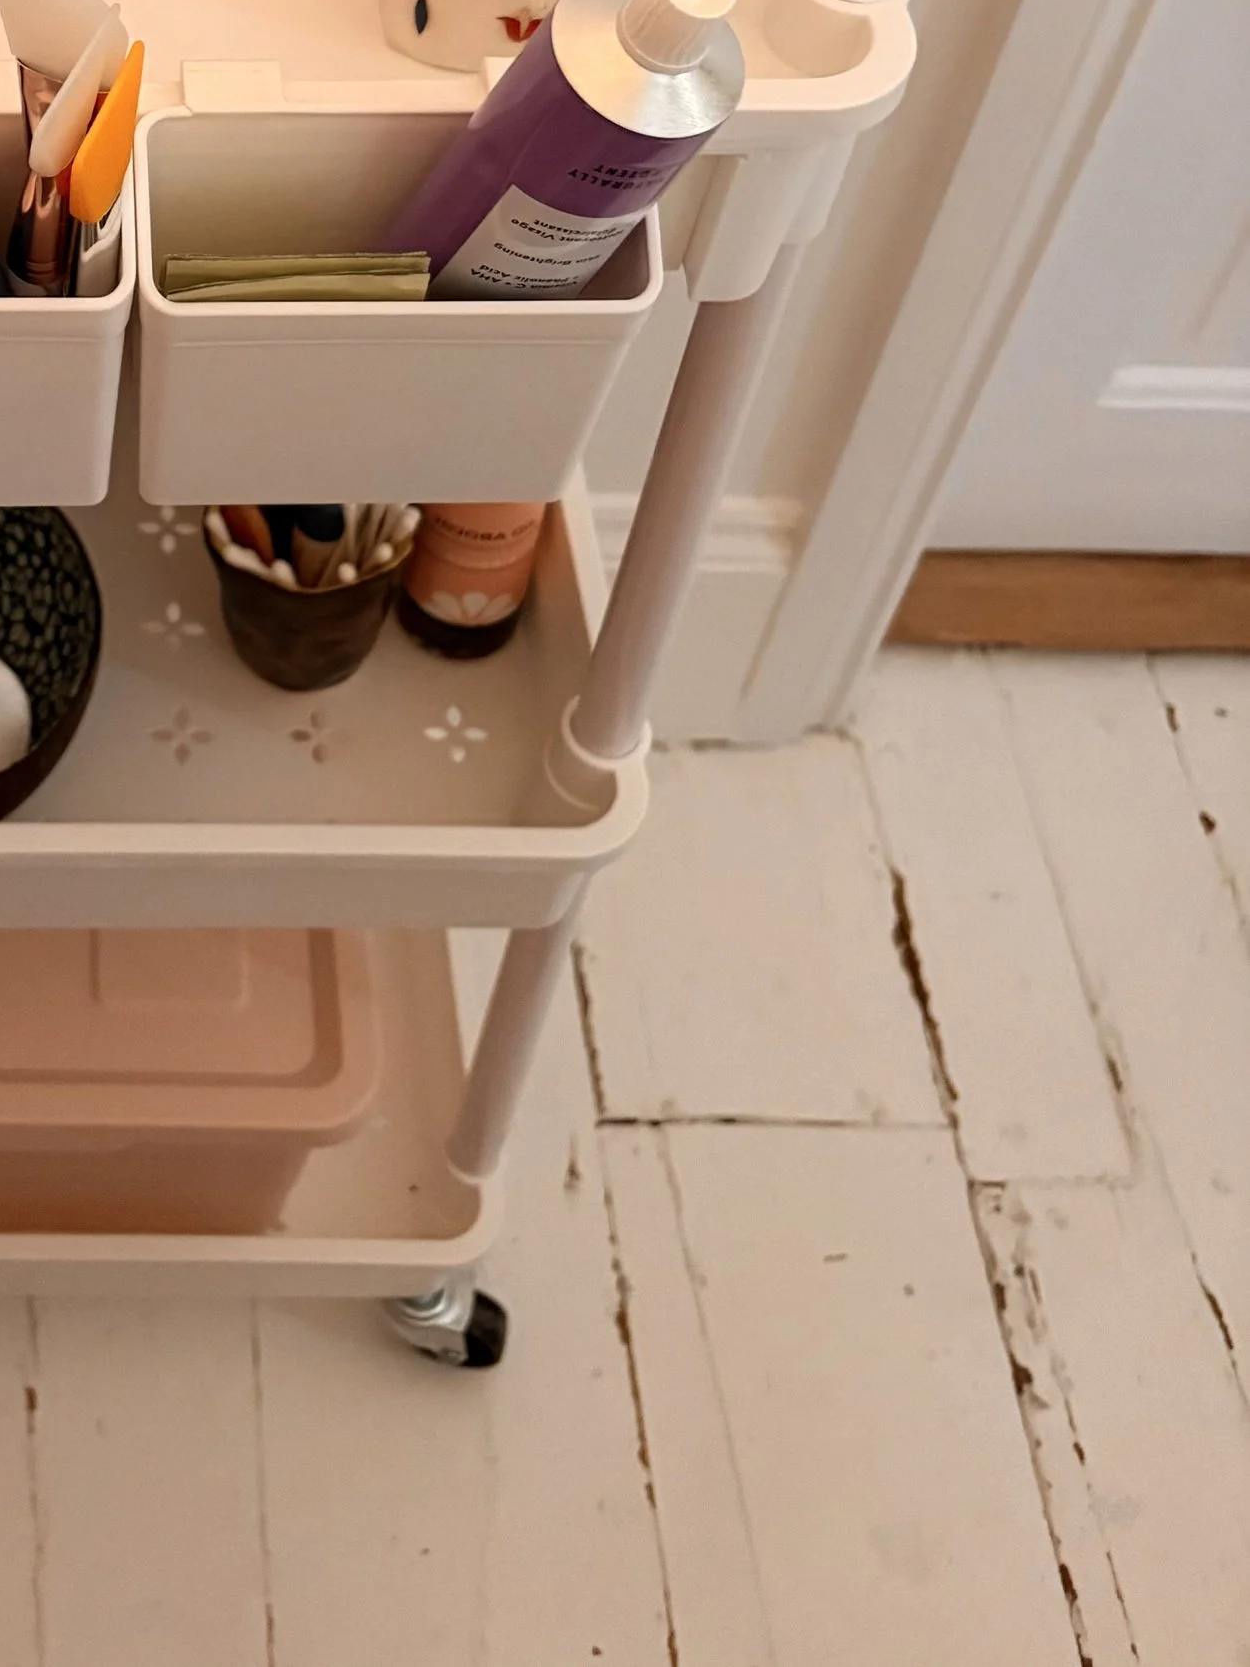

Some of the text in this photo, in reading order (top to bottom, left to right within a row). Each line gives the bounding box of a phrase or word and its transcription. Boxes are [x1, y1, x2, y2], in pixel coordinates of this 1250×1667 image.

[493, 242, 572, 266] Brightening
[470, 267, 502, 284] AHA
[479, 264, 511, 279] Acid
